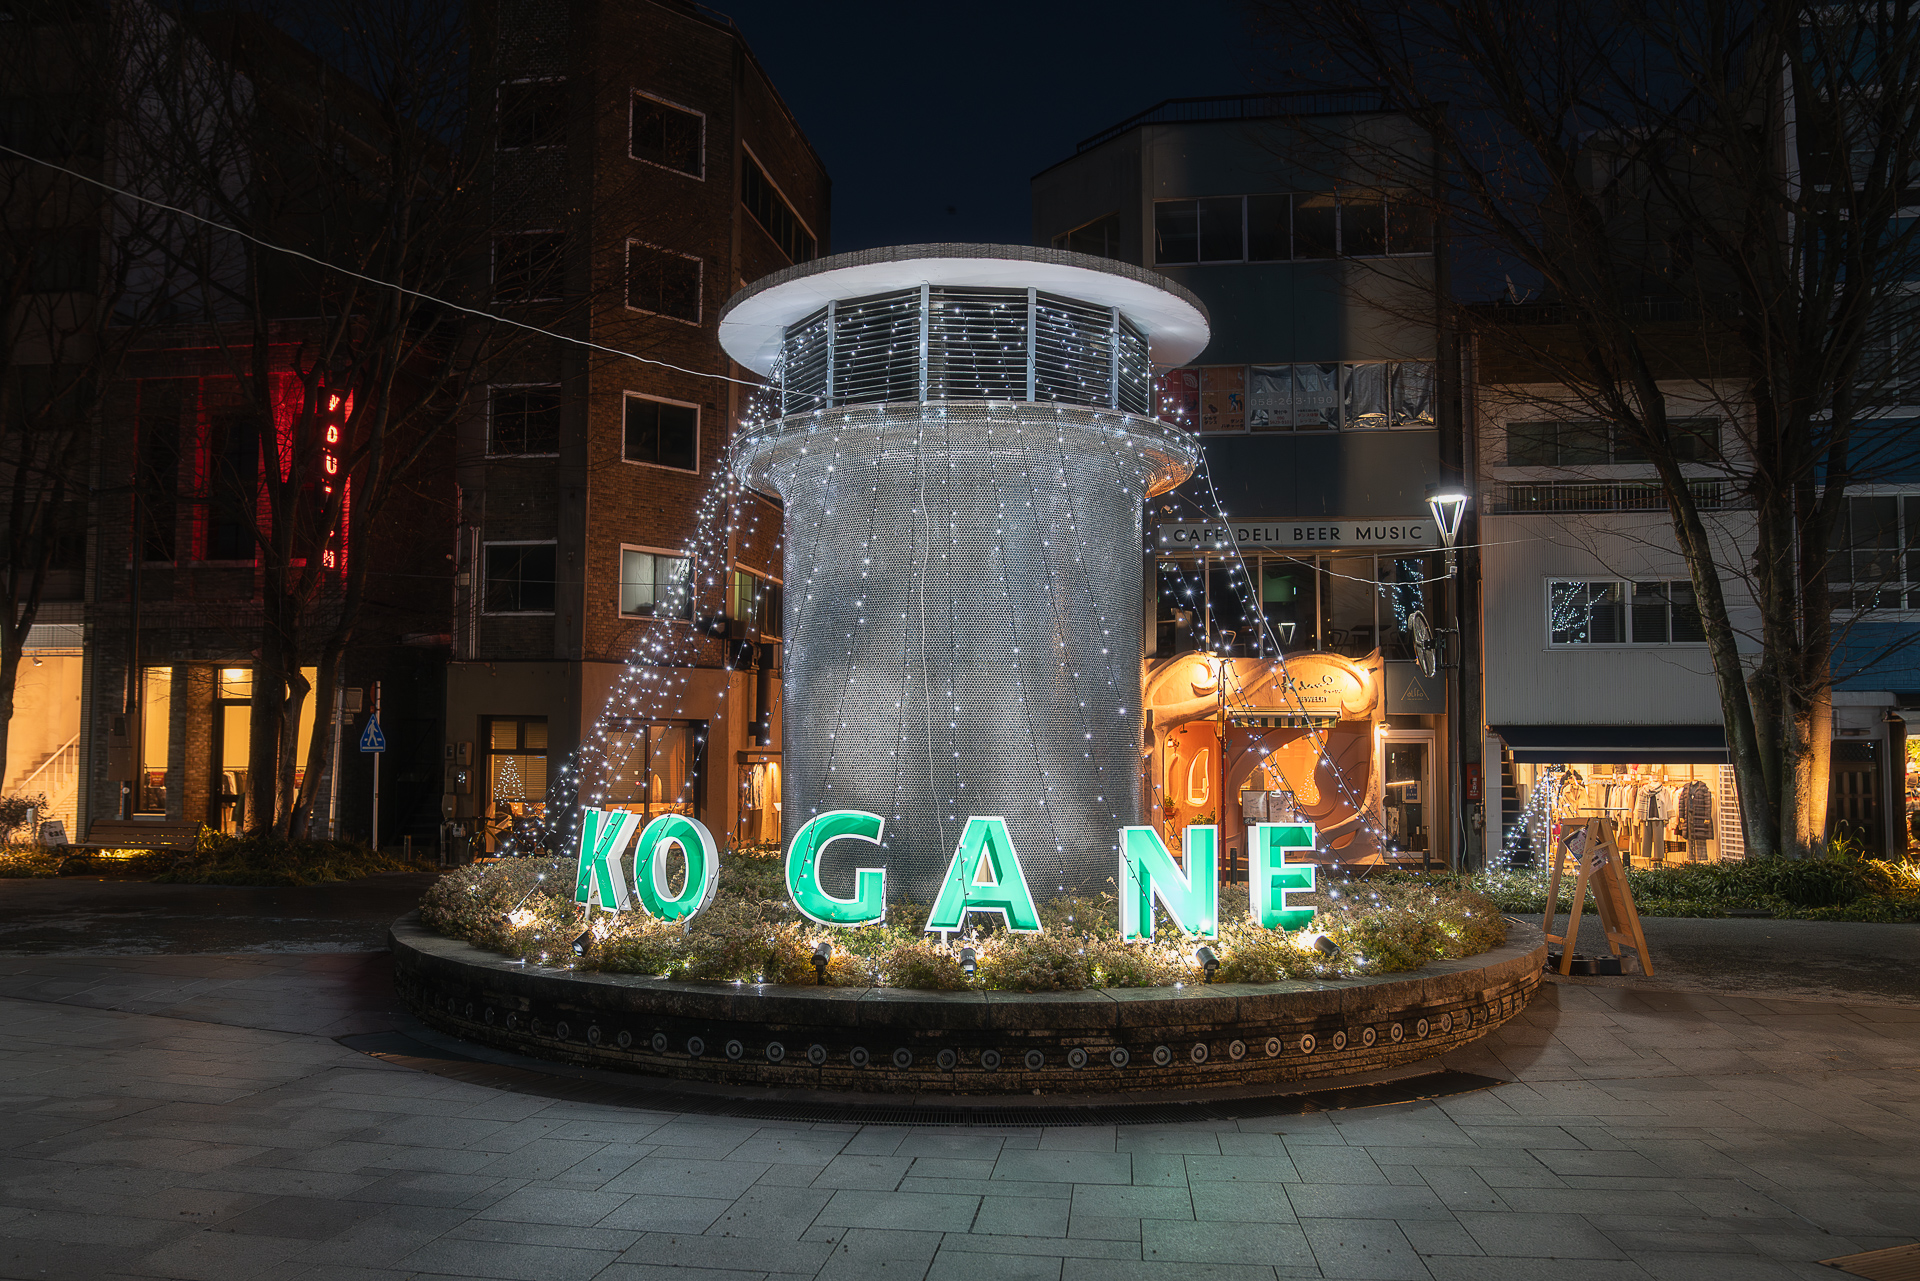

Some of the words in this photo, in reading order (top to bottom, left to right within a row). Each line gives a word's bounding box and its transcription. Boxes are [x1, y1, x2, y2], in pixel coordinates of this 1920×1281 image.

[1173, 528, 1224, 543] CAFE
[1238, 528, 1280, 542] DELI
[1293, 527, 1341, 541] BEER
[1355, 526, 1423, 540] MUSIC
